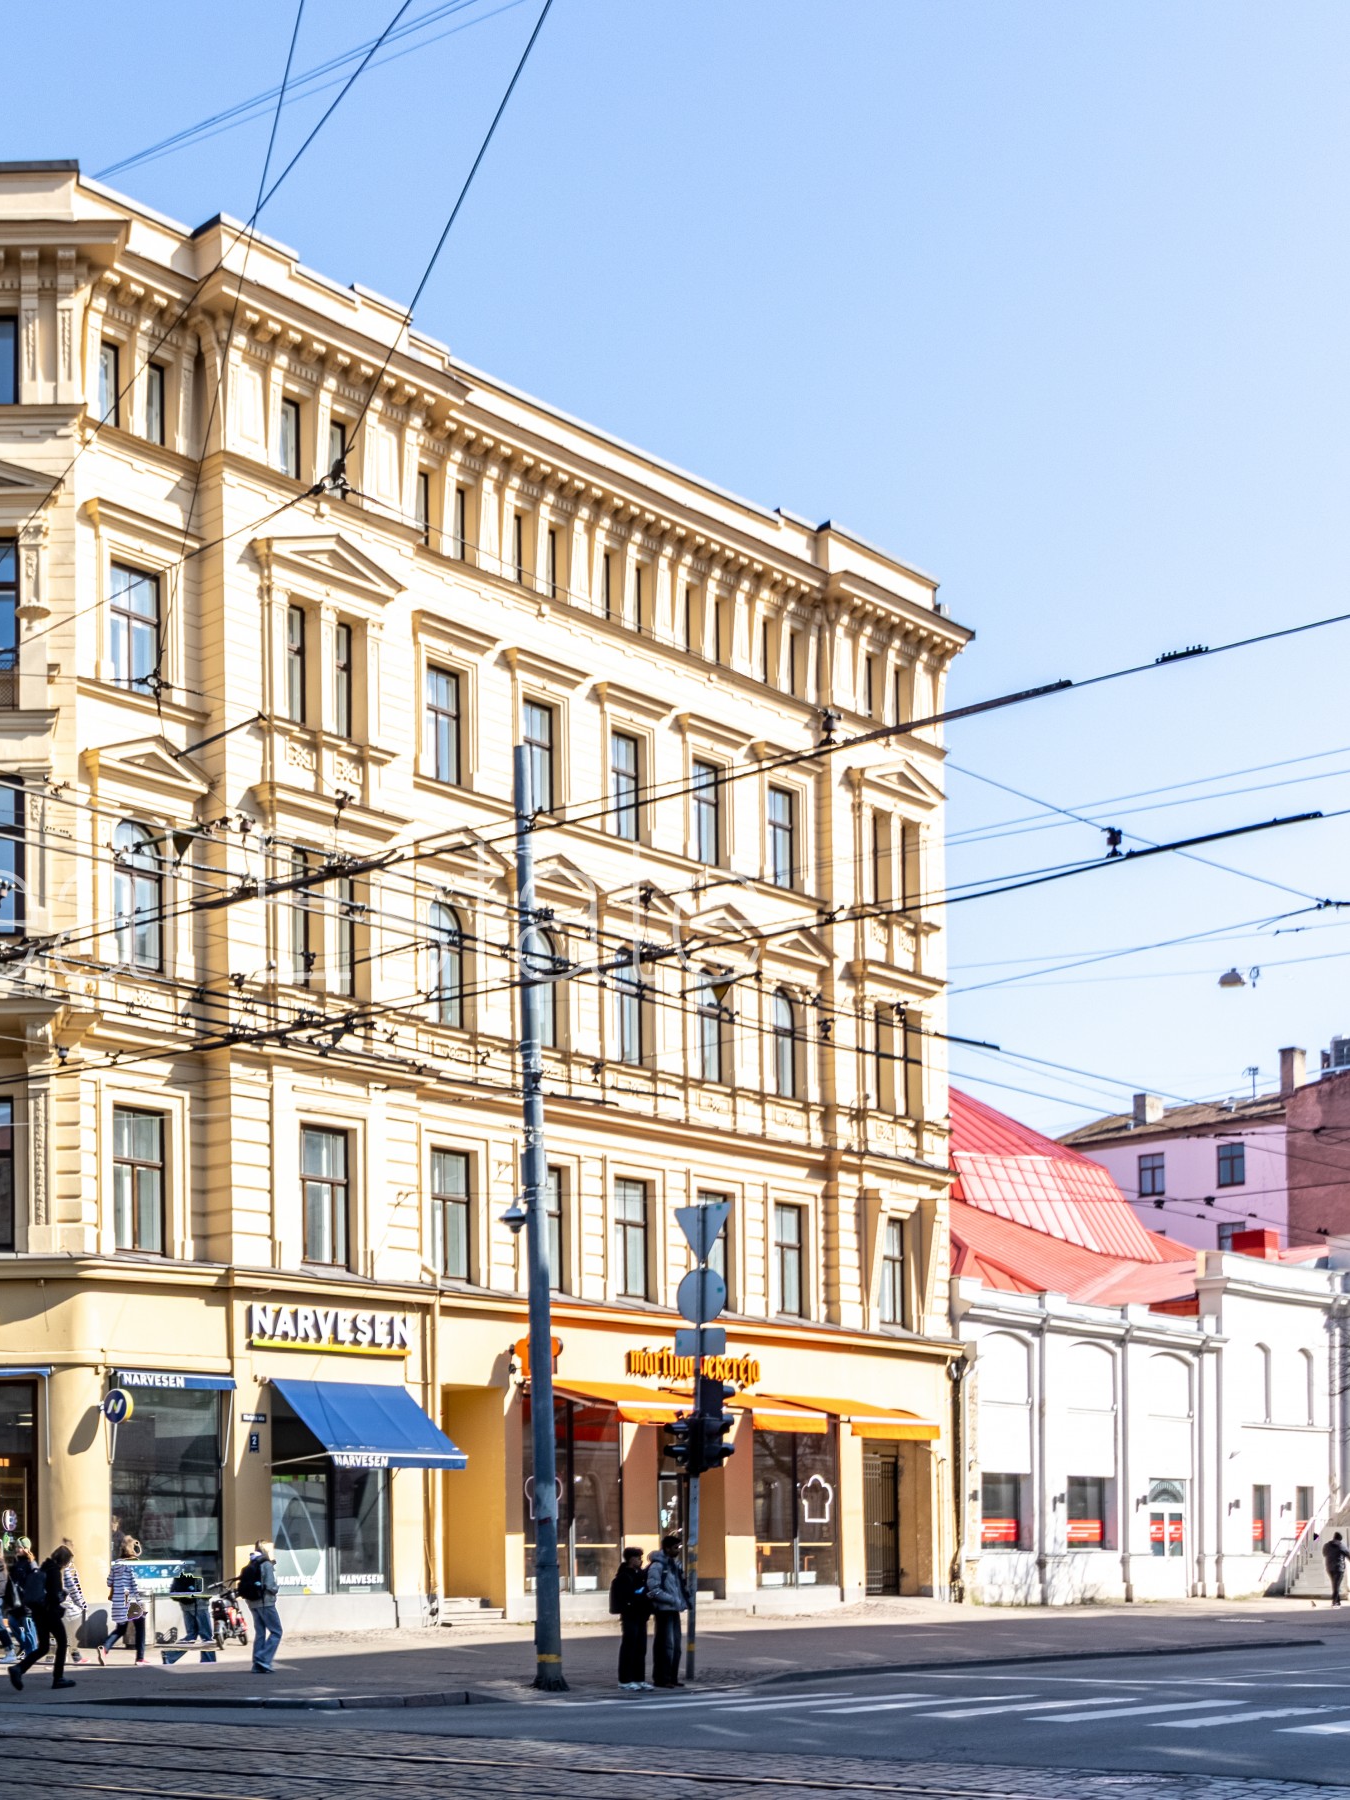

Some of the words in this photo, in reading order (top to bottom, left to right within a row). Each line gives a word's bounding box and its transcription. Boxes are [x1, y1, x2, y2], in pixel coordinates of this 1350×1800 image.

[252, 1302, 412, 1345] NARVESEN
[123, 1373, 185, 1388] NARVESEN
[252, 1436, 257, 1445] 2
[333, 1454, 389, 1467] NARVESEN
[277, 1575, 321, 1586] NARVES
[339, 1574, 384, 1585] NARVESEN
